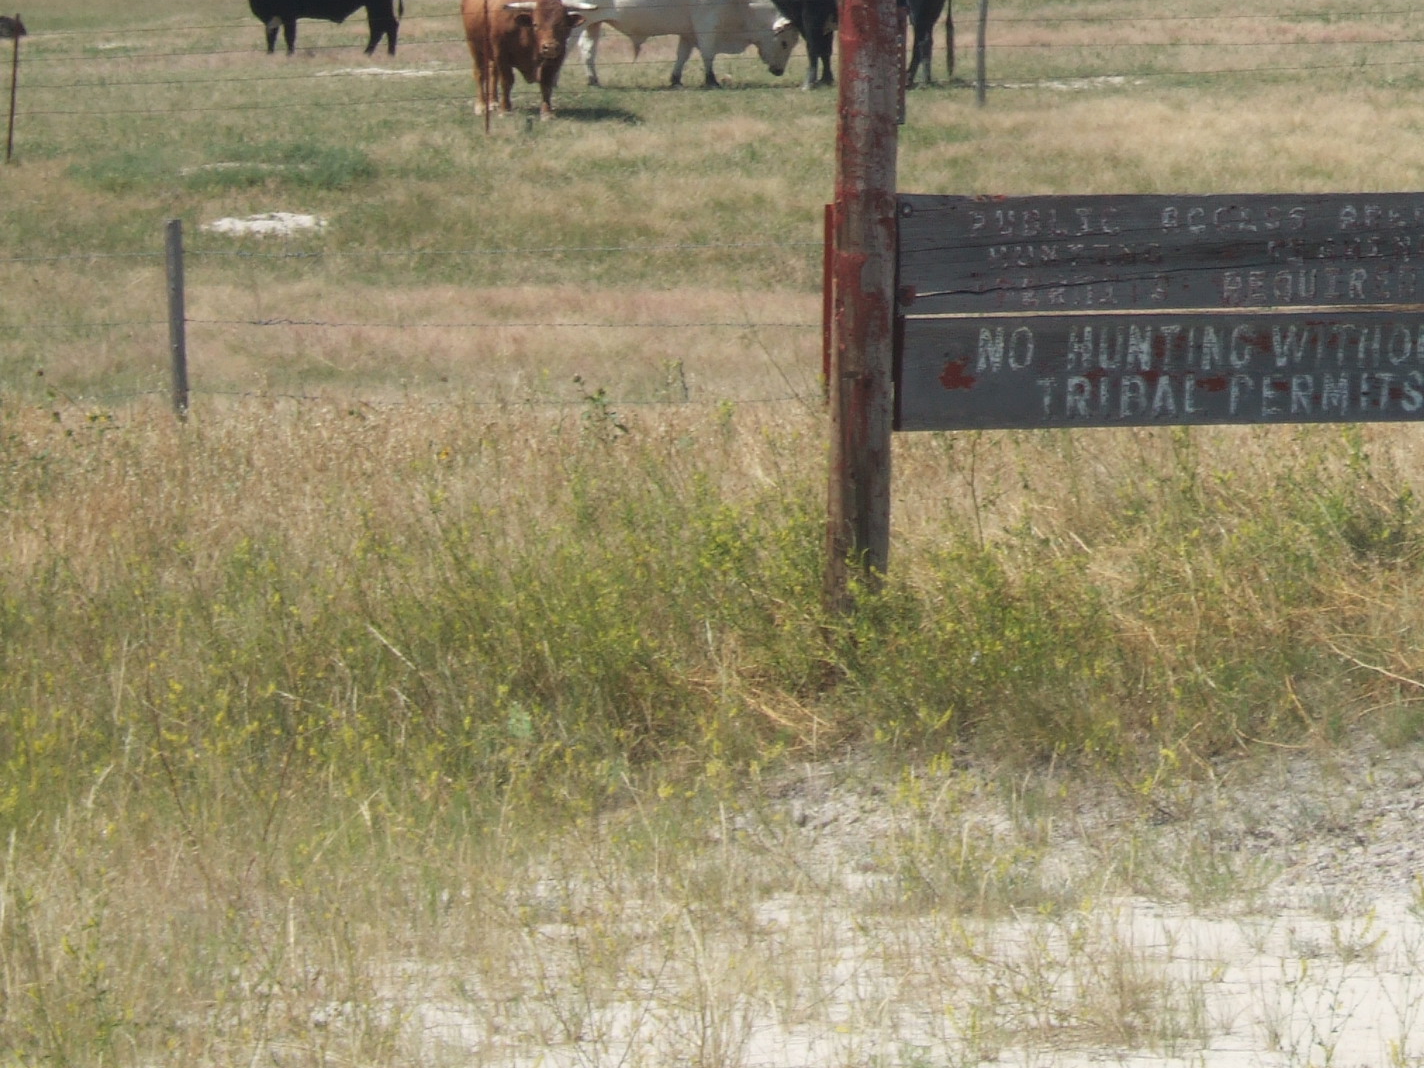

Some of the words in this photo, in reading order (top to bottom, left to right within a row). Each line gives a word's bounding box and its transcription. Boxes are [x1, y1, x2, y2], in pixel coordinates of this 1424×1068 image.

[977, 325, 1034, 373] NO
[1067, 323, 1256, 371] HUNTING
[1228, 370, 1424, 416] PERMITS
